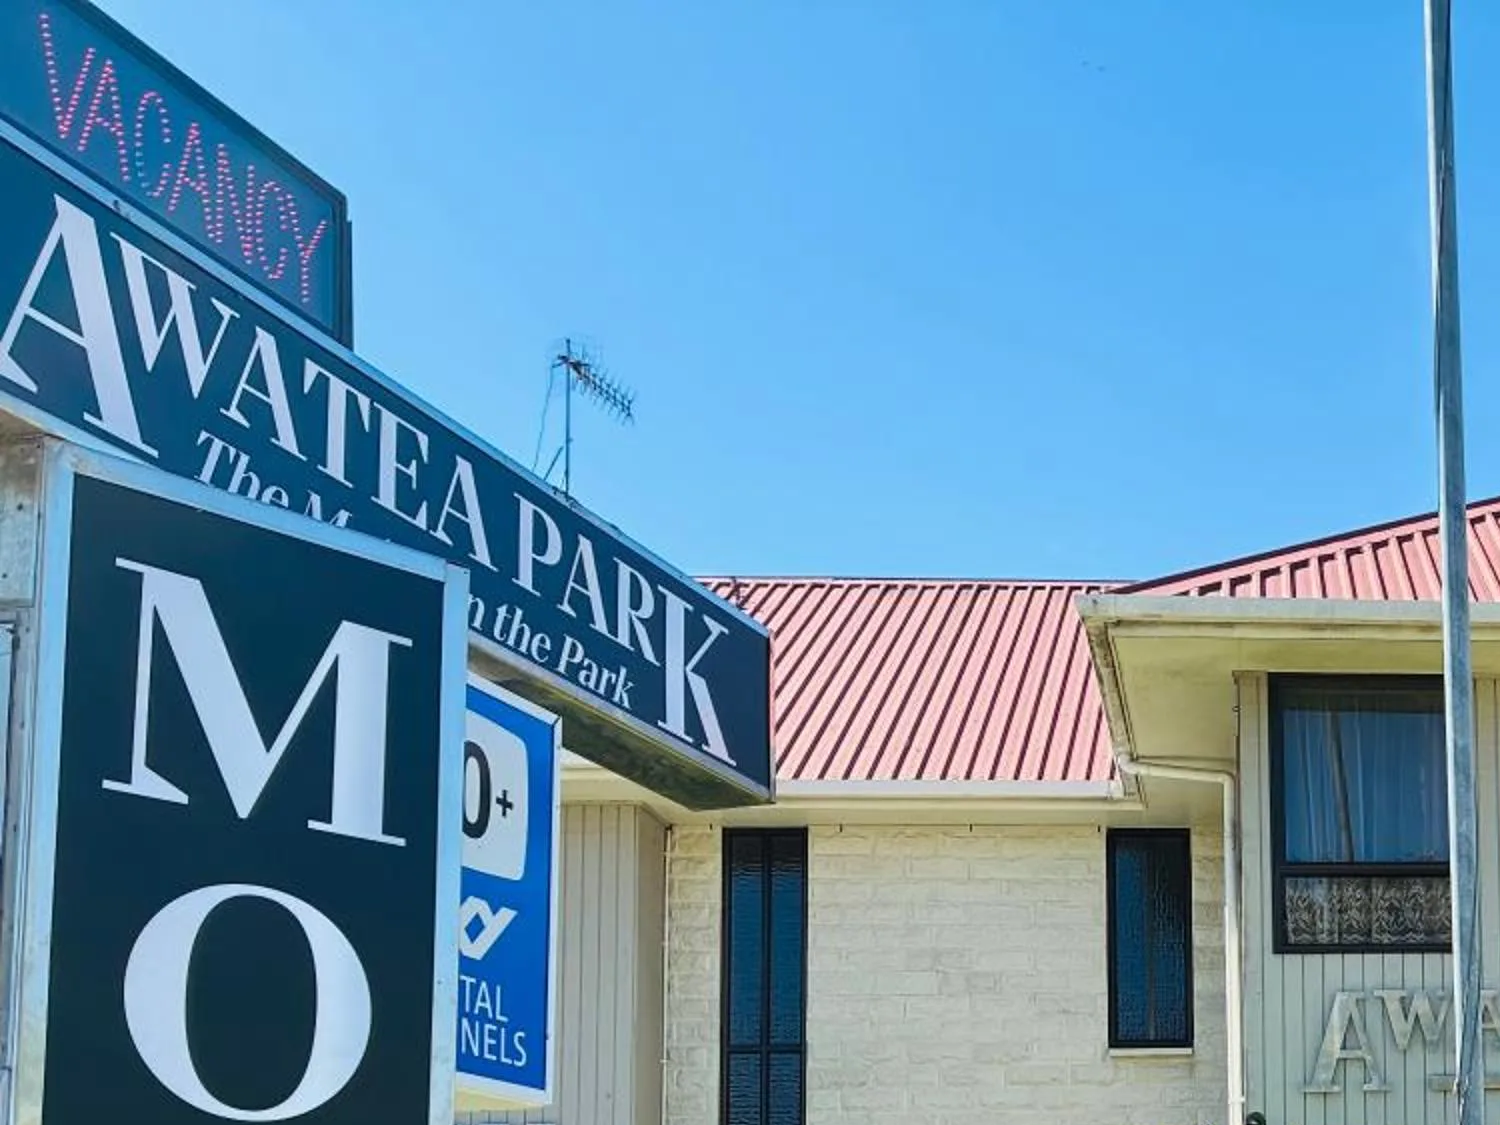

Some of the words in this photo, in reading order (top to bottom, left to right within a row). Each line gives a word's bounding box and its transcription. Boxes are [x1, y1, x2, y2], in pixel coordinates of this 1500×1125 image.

[38, 13, 329, 303] VACANCY
[0, 193, 499, 572] AWATEA
[513, 492, 738, 767] PARK
[493, 603, 552, 664] the
[555, 633, 636, 711] Park
